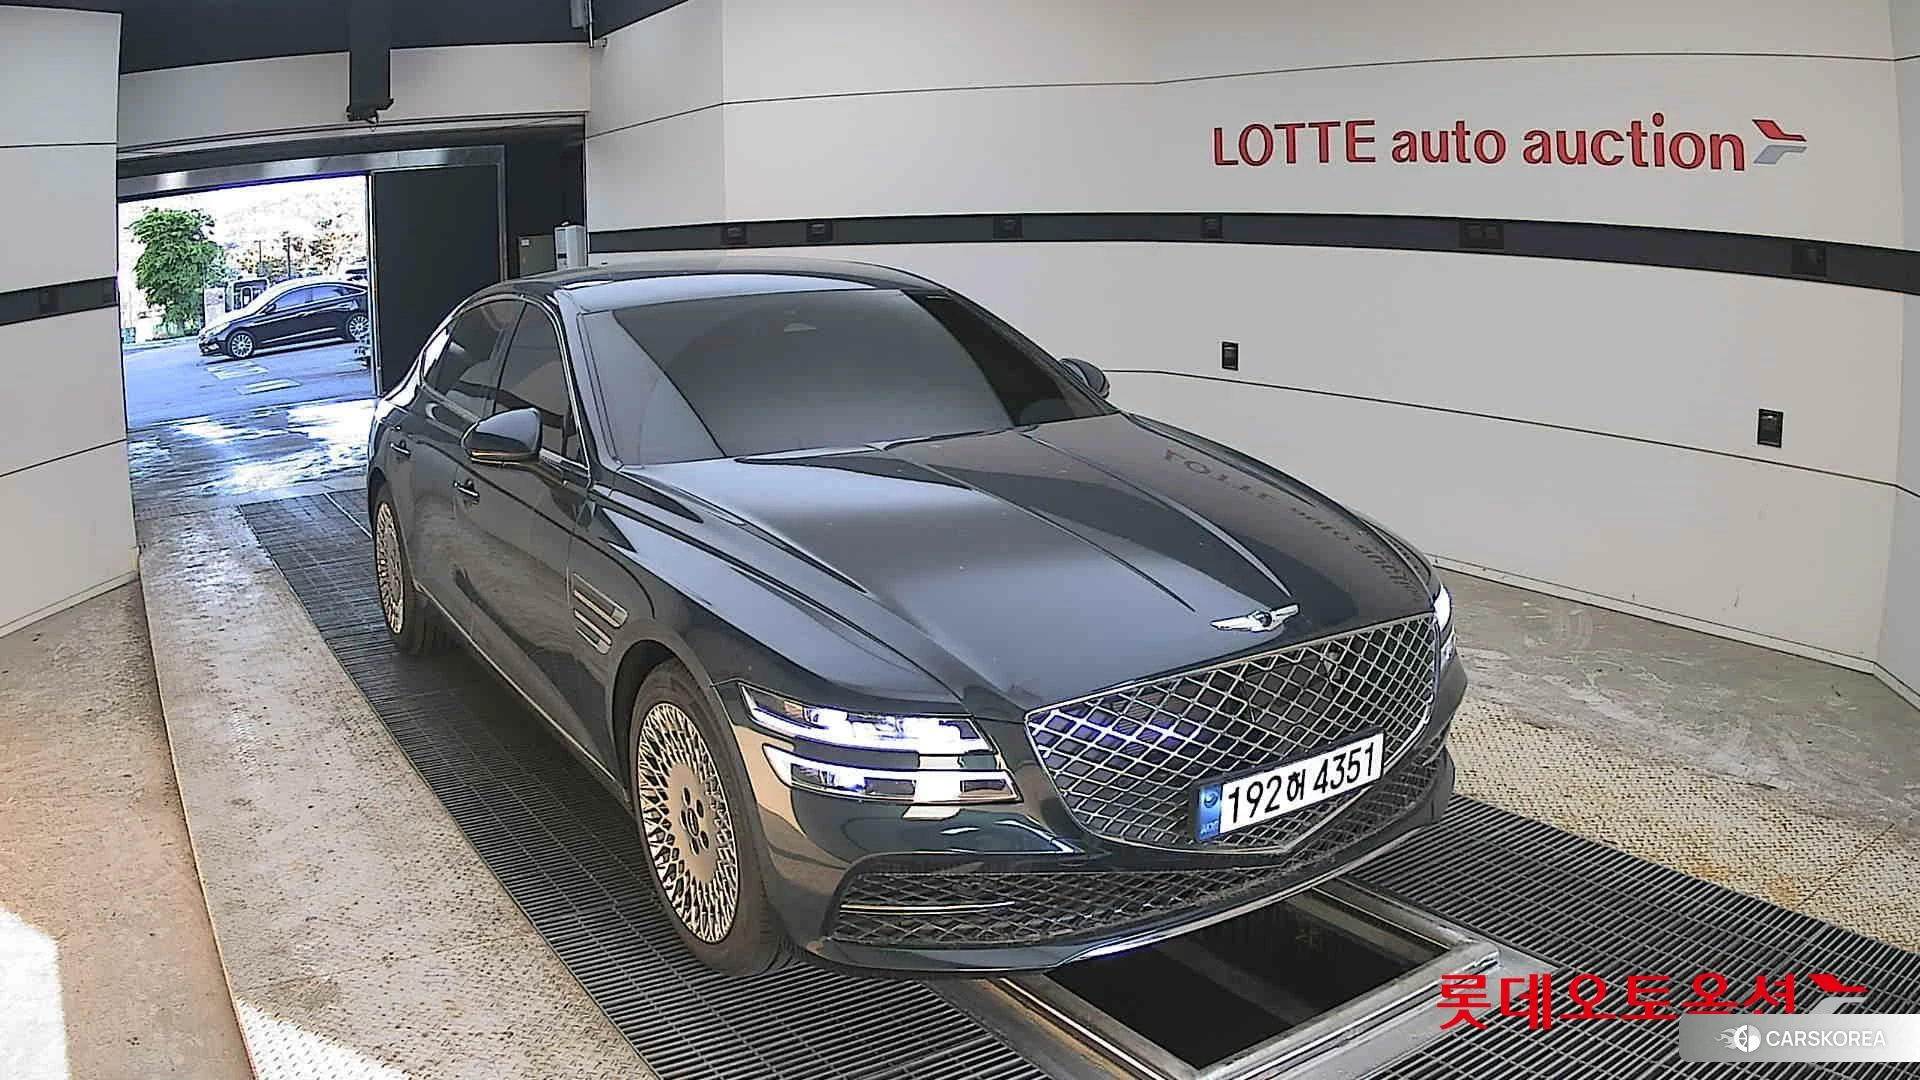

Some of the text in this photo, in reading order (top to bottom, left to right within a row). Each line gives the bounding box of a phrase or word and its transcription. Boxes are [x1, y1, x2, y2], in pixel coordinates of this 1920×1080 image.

[1213, 112, 1746, 171] LOTTE auto auction
[1313, 742, 1375, 794] 4351
